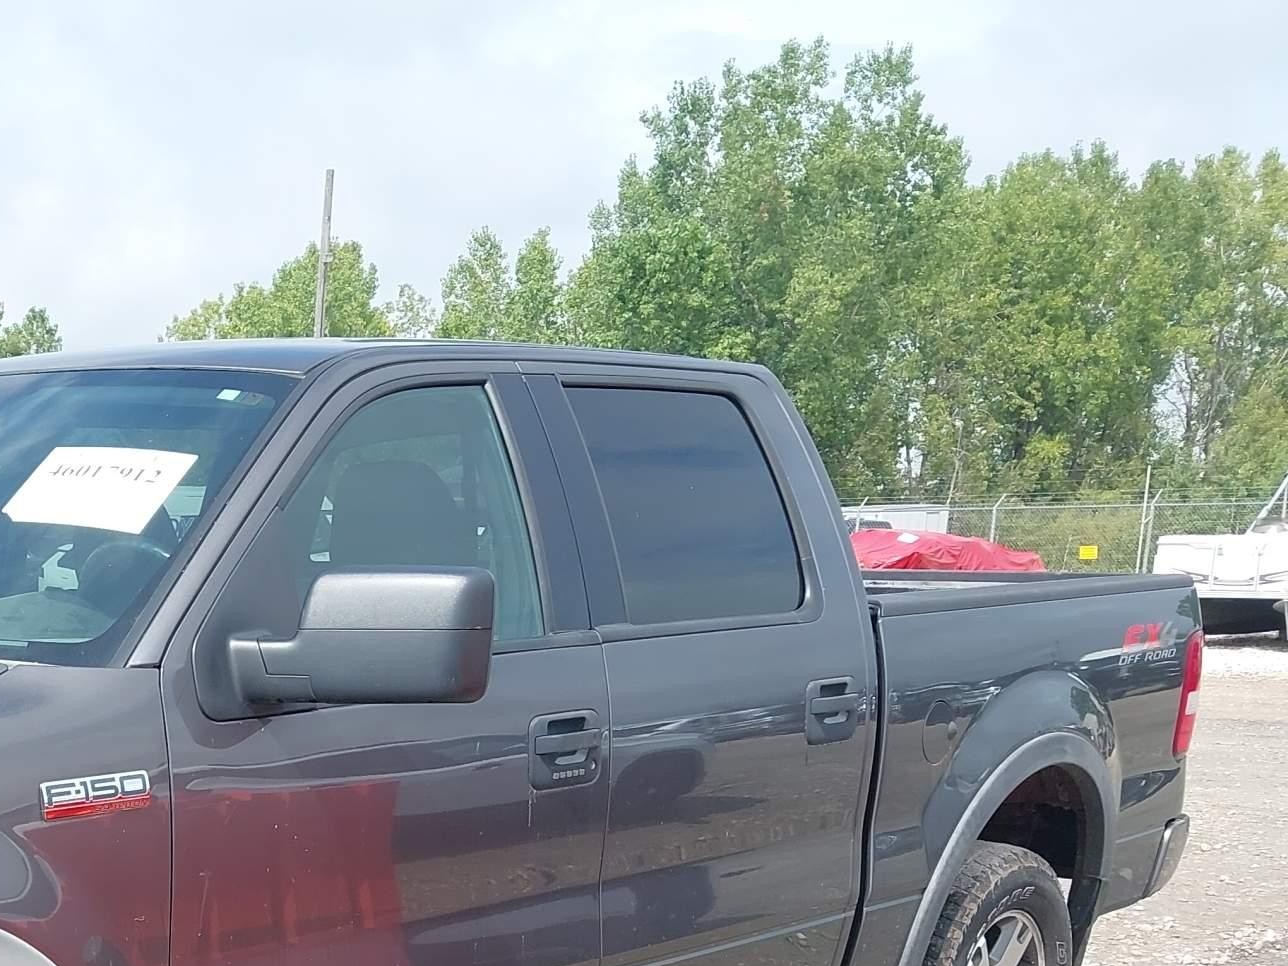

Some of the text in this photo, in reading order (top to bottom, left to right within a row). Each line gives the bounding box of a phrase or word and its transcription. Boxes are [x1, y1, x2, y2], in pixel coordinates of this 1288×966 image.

[1118, 648, 1177, 666] OFF ROAD
[42, 771, 150, 807] F-150
